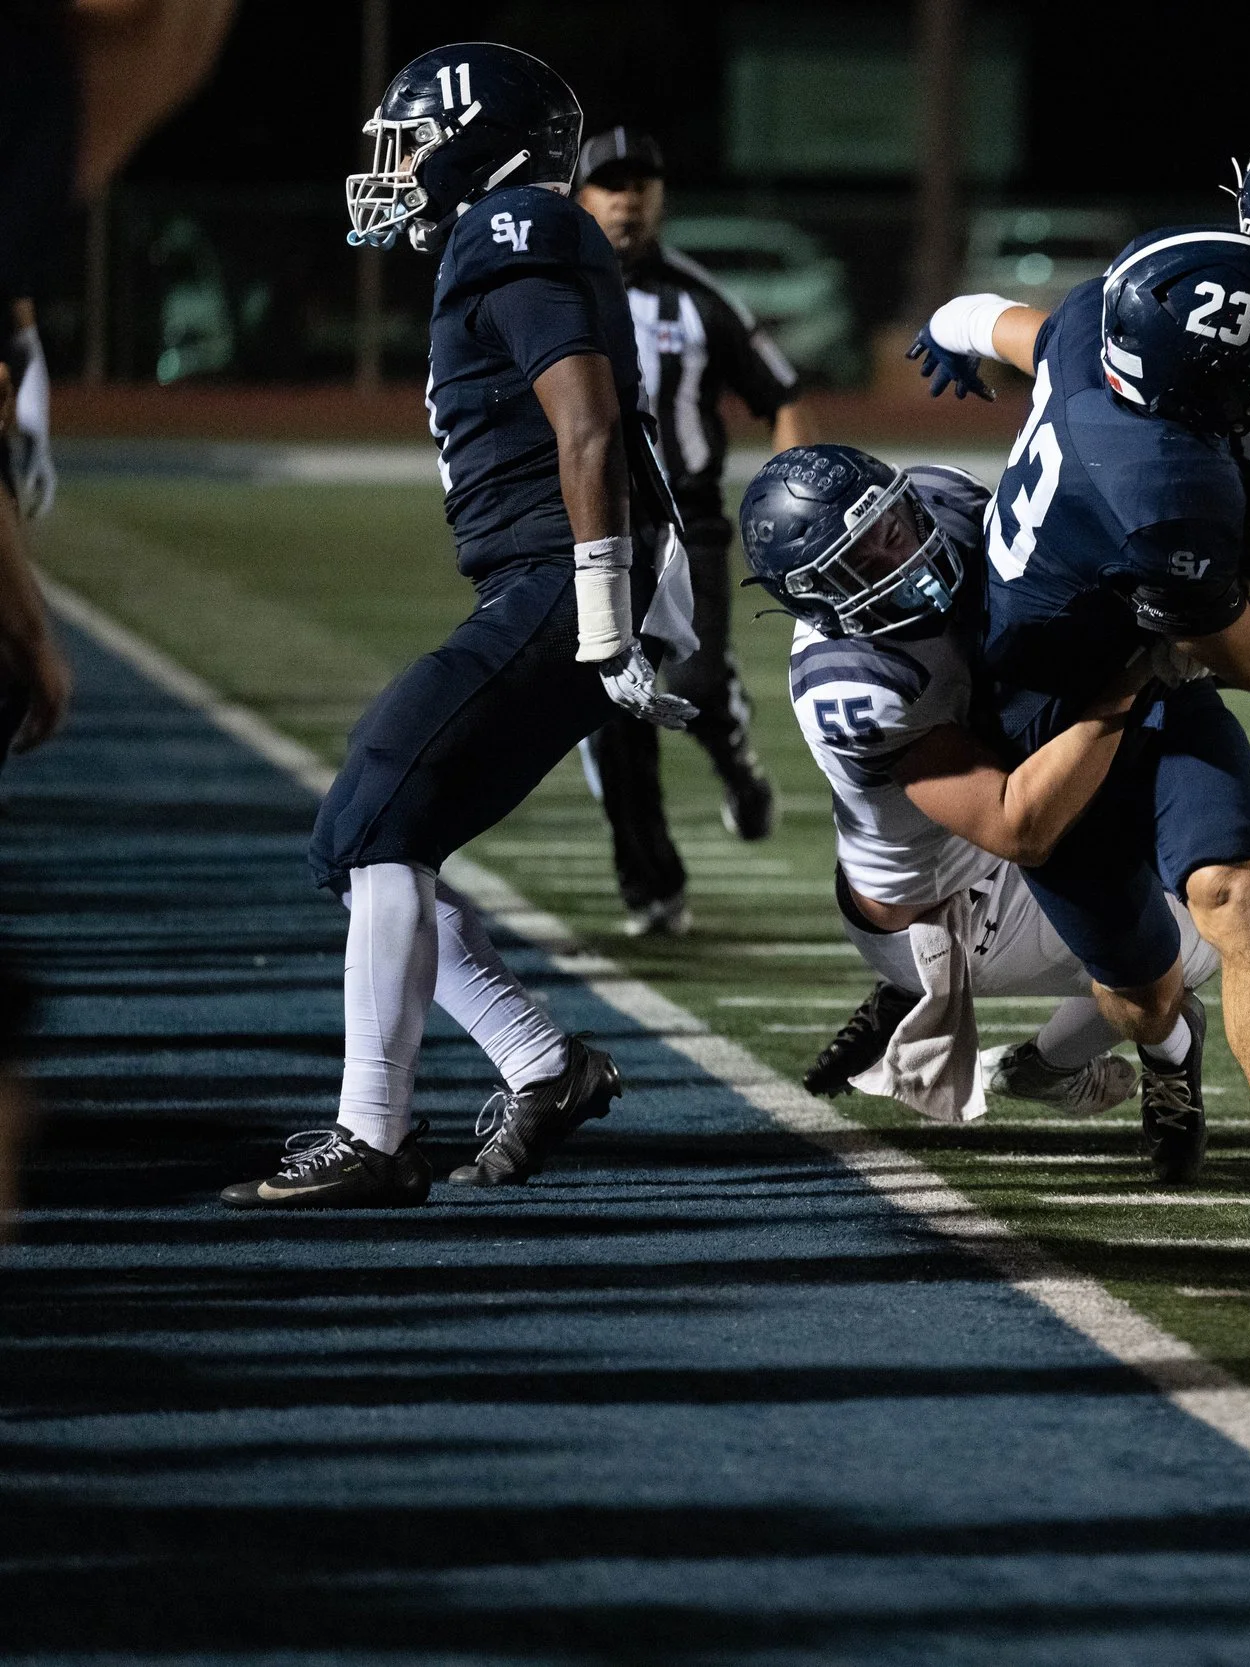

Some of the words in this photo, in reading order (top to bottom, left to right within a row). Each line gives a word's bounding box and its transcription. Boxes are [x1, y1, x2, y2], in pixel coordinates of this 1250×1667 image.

[436, 62, 472, 110] 11
[490, 211, 532, 253] SV
[1170, 550, 1211, 580] SV
[813, 695, 884, 744] 55
